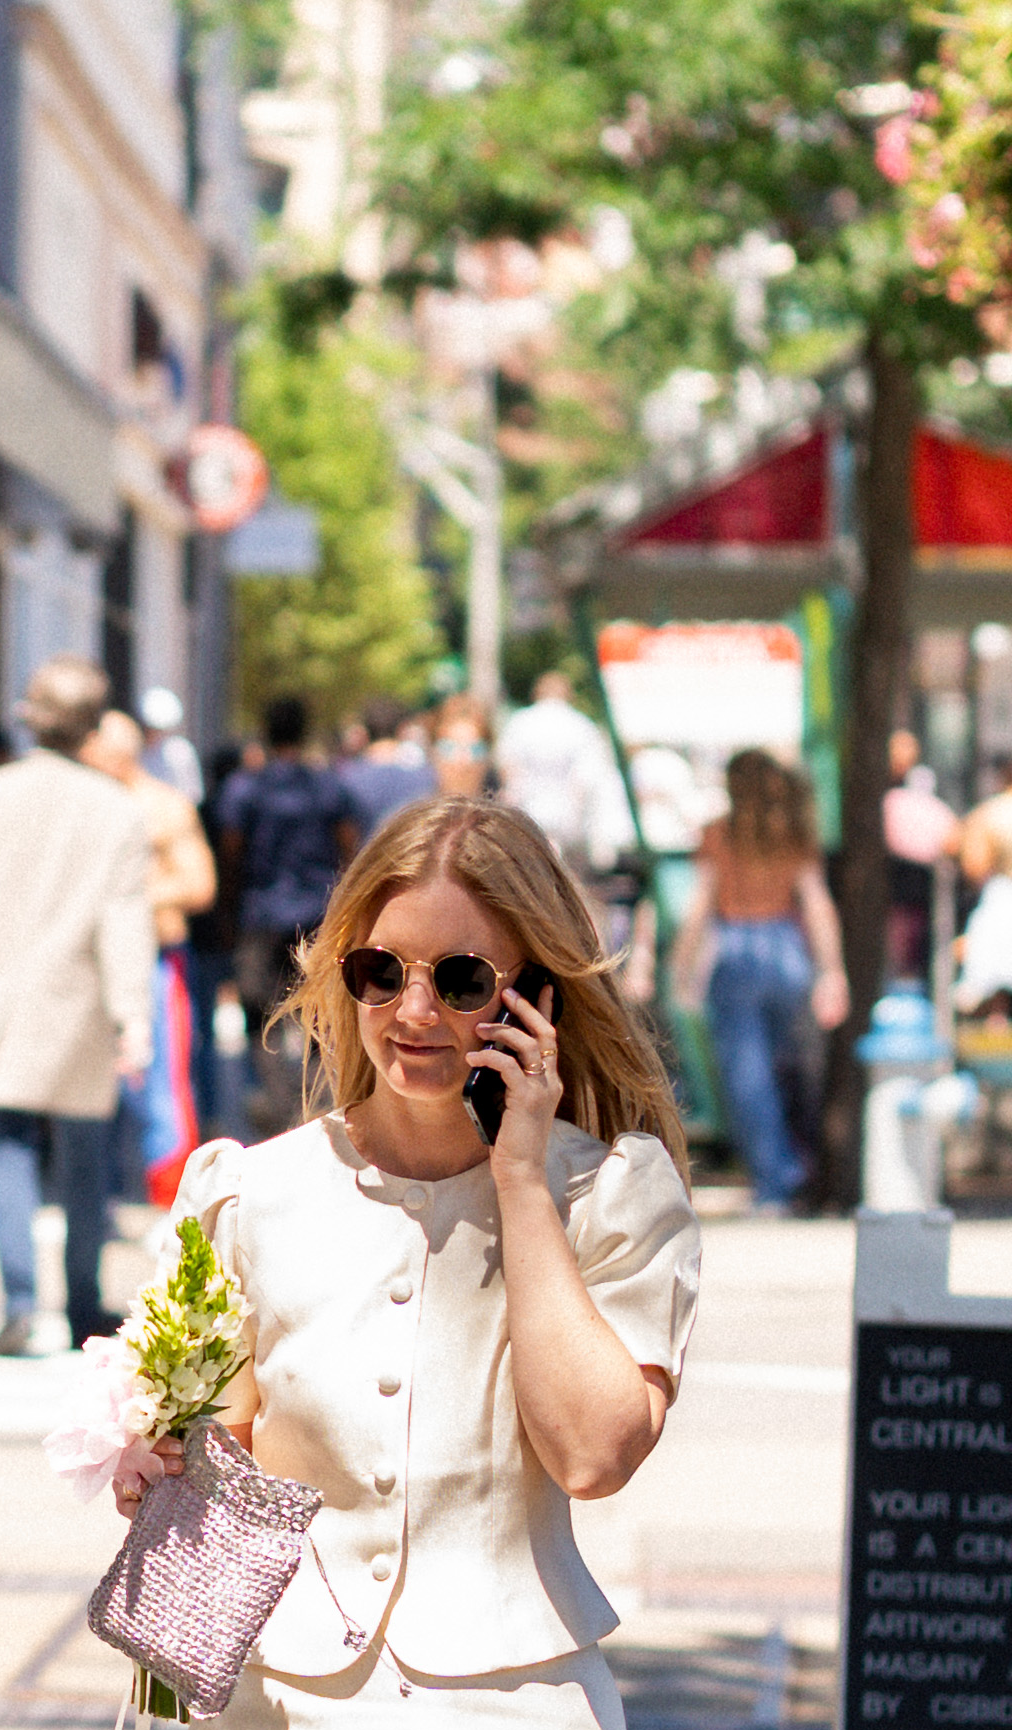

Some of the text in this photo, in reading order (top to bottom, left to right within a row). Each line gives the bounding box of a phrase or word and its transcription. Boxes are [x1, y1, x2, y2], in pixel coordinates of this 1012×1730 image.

[890, 1348, 949, 1366] YOUR
[882, 1377, 1000, 1404] LIGHT IS
[870, 1491, 948, 1517] YOUR
[869, 1532, 894, 1556] IS
[917, 1535, 934, 1555] A
[866, 1613, 1003, 1640] ARTWORK
[864, 1653, 982, 1679] MASARY
[863, 1693, 900, 1717] BY
